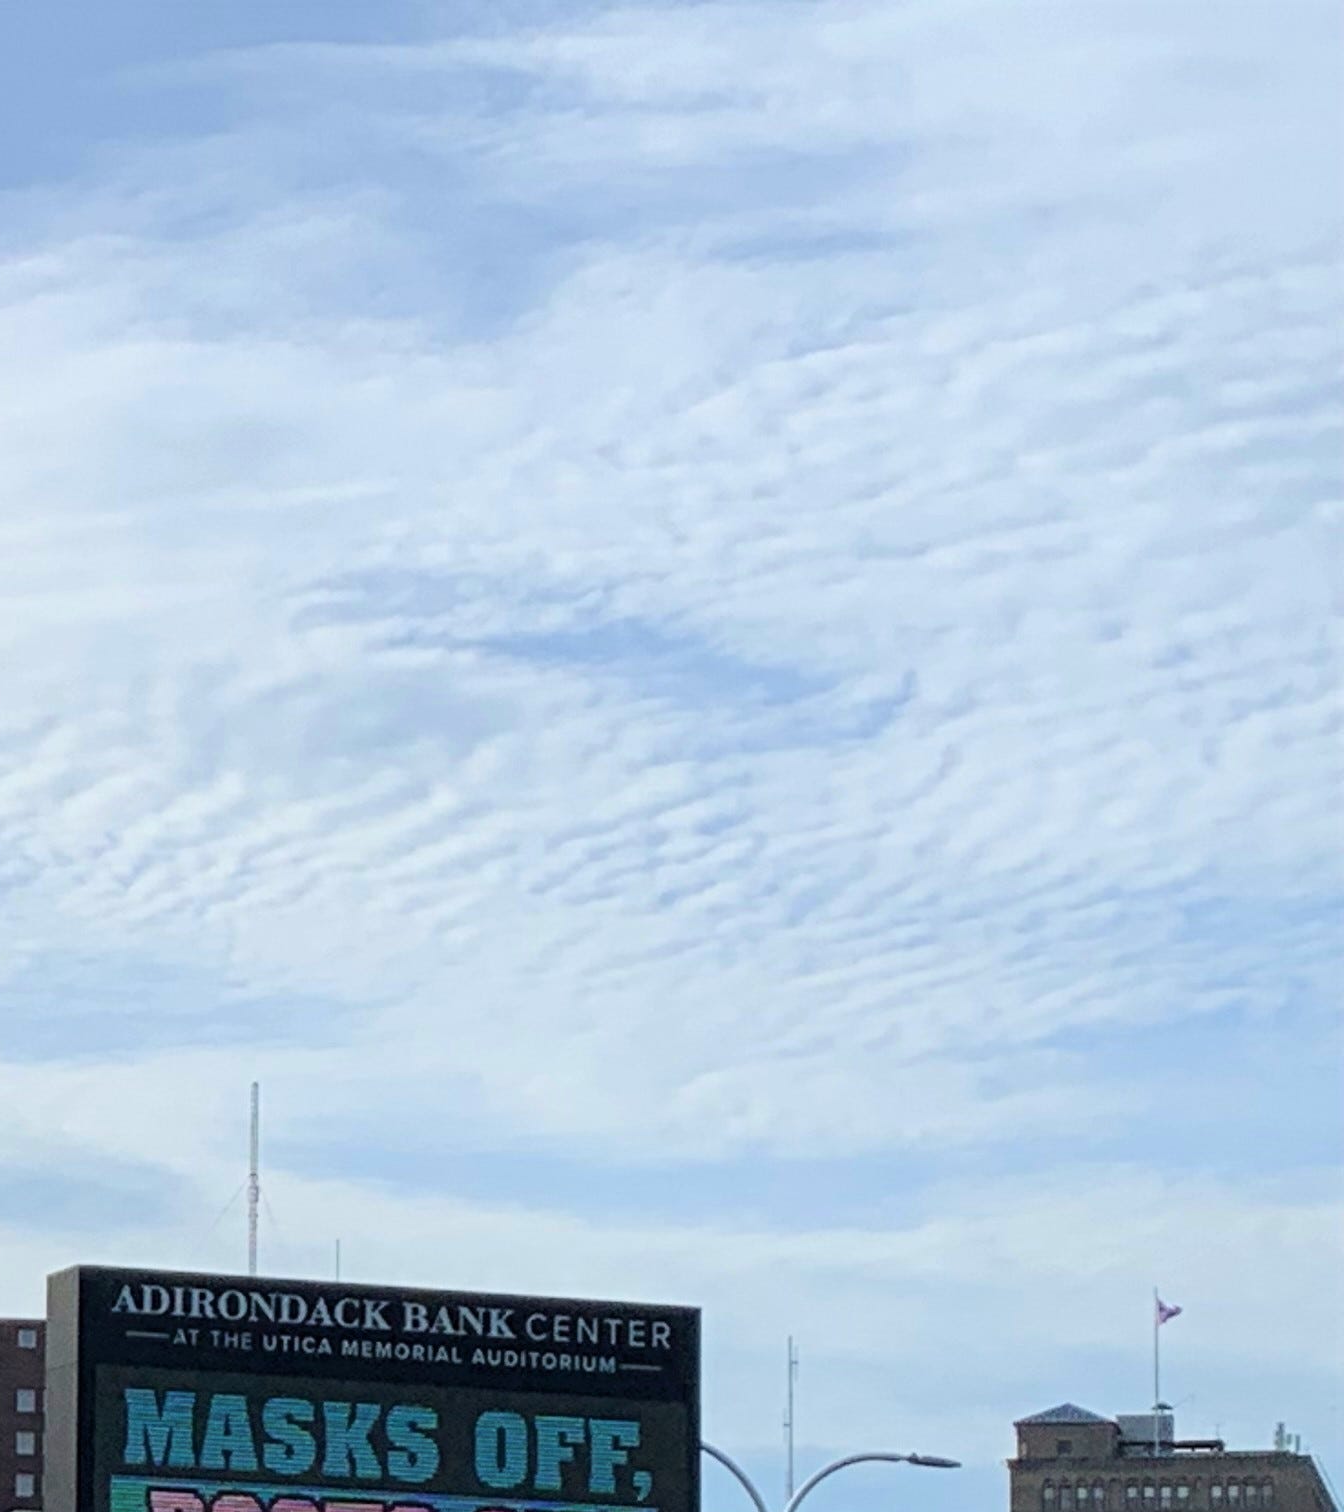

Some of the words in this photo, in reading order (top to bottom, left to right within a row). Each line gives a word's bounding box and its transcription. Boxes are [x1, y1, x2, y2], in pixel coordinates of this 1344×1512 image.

[112, 1284, 392, 1331] ADIRONDACK
[402, 1302, 516, 1339] BANK
[525, 1312, 672, 1349] CENTER
[173, 1328, 199, 1346] AT
[212, 1330, 252, 1350] THE
[263, 1334, 332, 1355] UTICA
[341, 1339, 462, 1365] MEMORIAL
[471, 1348, 617, 1374] AUDITORIUM
[123, 1387, 440, 1484] MASKS
[474, 1410, 653, 1501] OFF,
